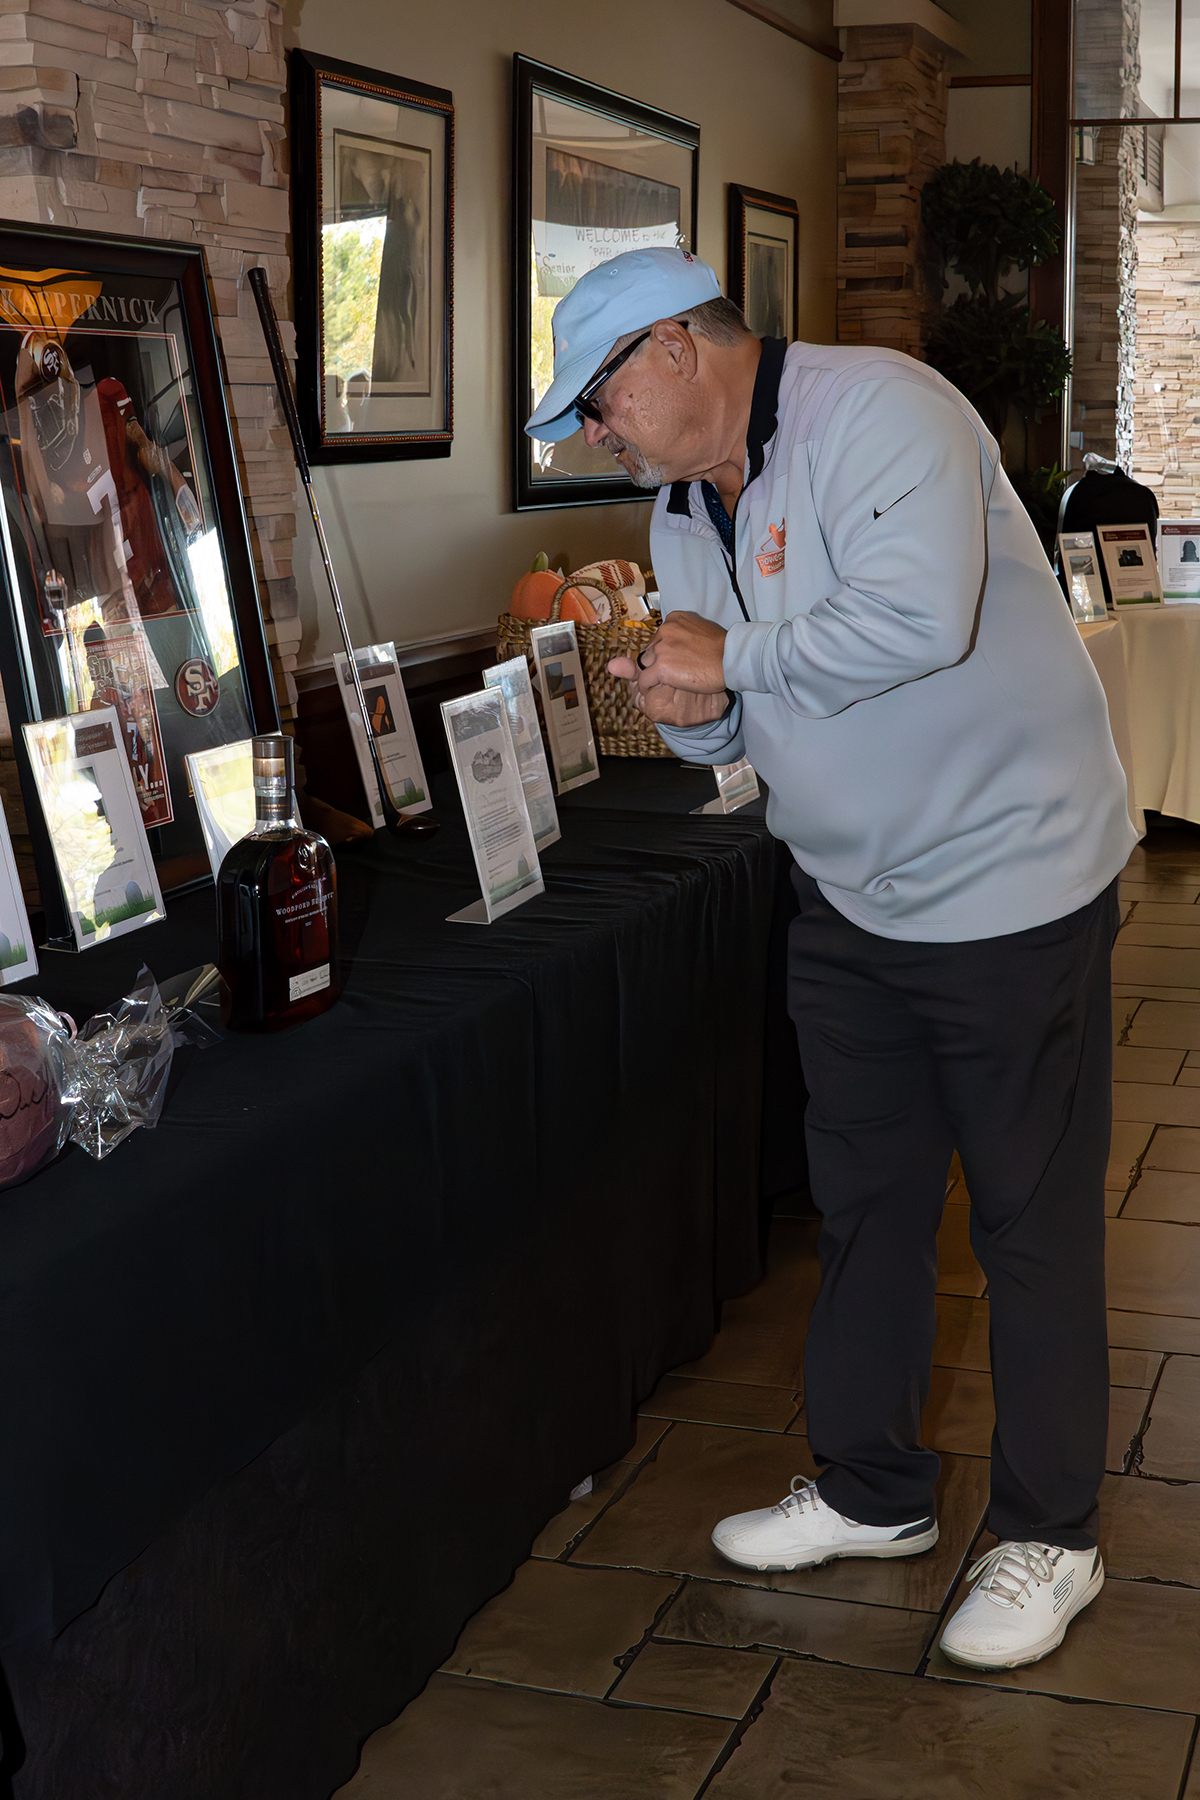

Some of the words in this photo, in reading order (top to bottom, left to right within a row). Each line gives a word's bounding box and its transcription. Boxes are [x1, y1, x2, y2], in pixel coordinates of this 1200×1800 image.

[575, 228, 640, 243] WELCOME
[539, 255, 575, 276] Senior
[0, 287, 160, 325] KAEPERNICK
[275, 900, 311, 916] WOODFORD
